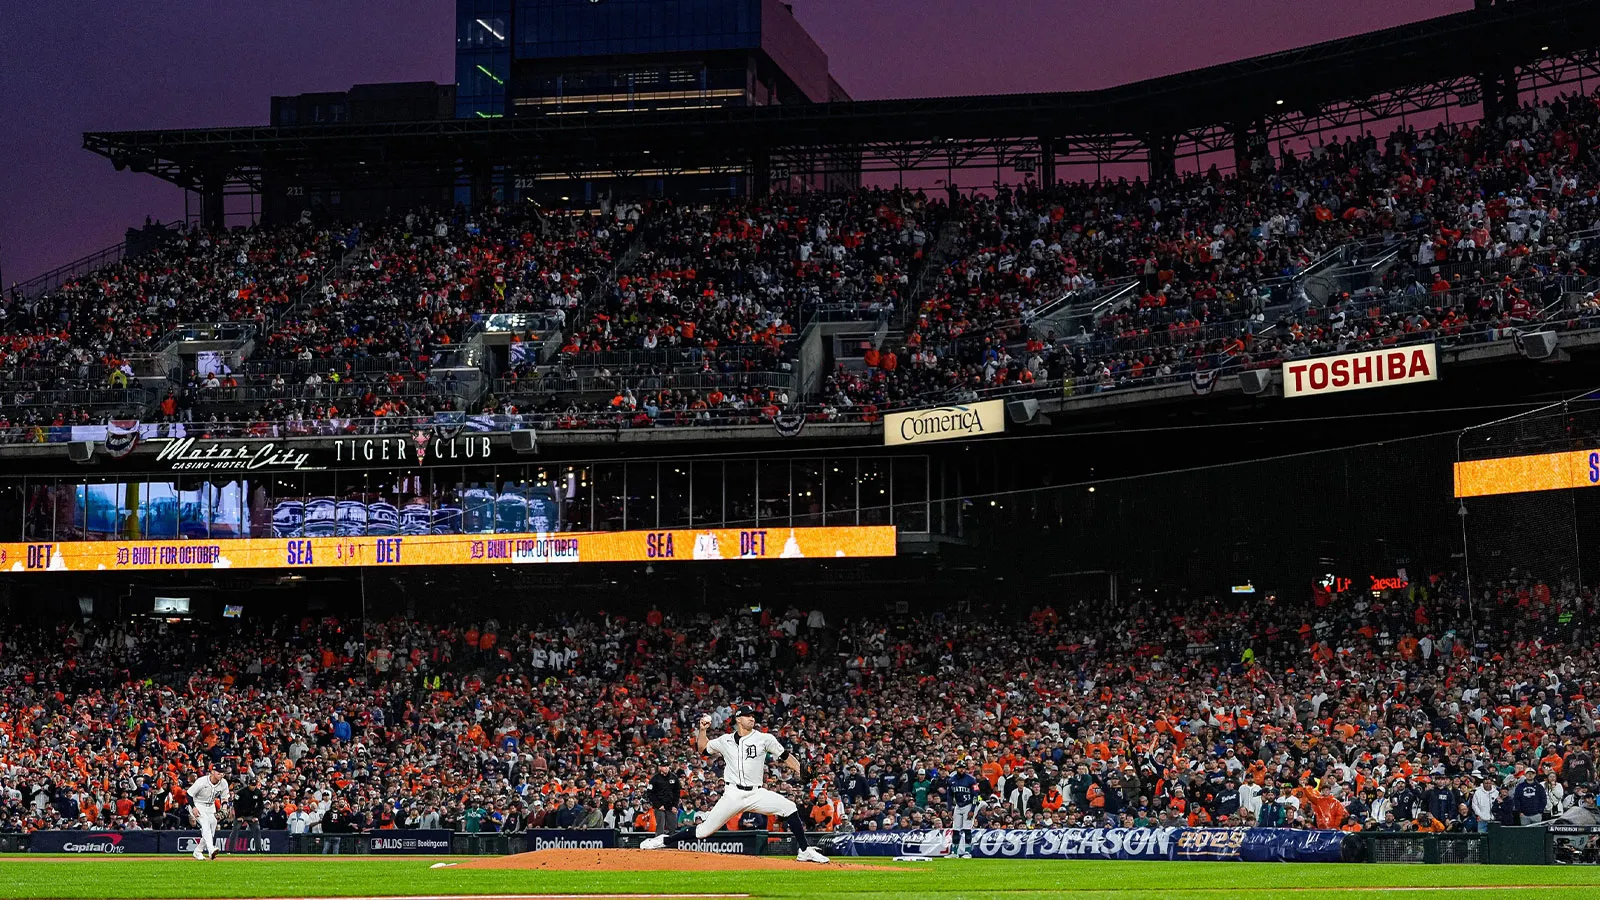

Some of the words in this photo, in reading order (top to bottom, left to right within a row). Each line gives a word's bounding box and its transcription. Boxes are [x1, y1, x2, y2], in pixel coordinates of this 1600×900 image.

[515, 178, 534, 188] 212
[1289, 349, 1431, 392] TOSHIBA
[335, 439, 406, 461] TIGER
[435, 436, 491, 459] CLUB
[132, 546, 157, 565] BUILT
[160, 546, 177, 565] FOR
[179, 545, 220, 563] OCTOBER
[287, 540, 313, 565] SEA
[376, 538, 402, 563] DET
[487, 540, 513, 558] BUILT
[516, 540, 534, 558] FOR
[536, 538, 579, 557] OCTOBER
[646, 532, 674, 558] SEA
[740, 531, 767, 556] DET
[27, 544, 52, 568] DET
[382, 838, 402, 849] ALDS
[418, 839, 448, 849] Booking.com
[535, 837, 604, 851] Booking.com
[677, 839, 744, 854] Booking.com
